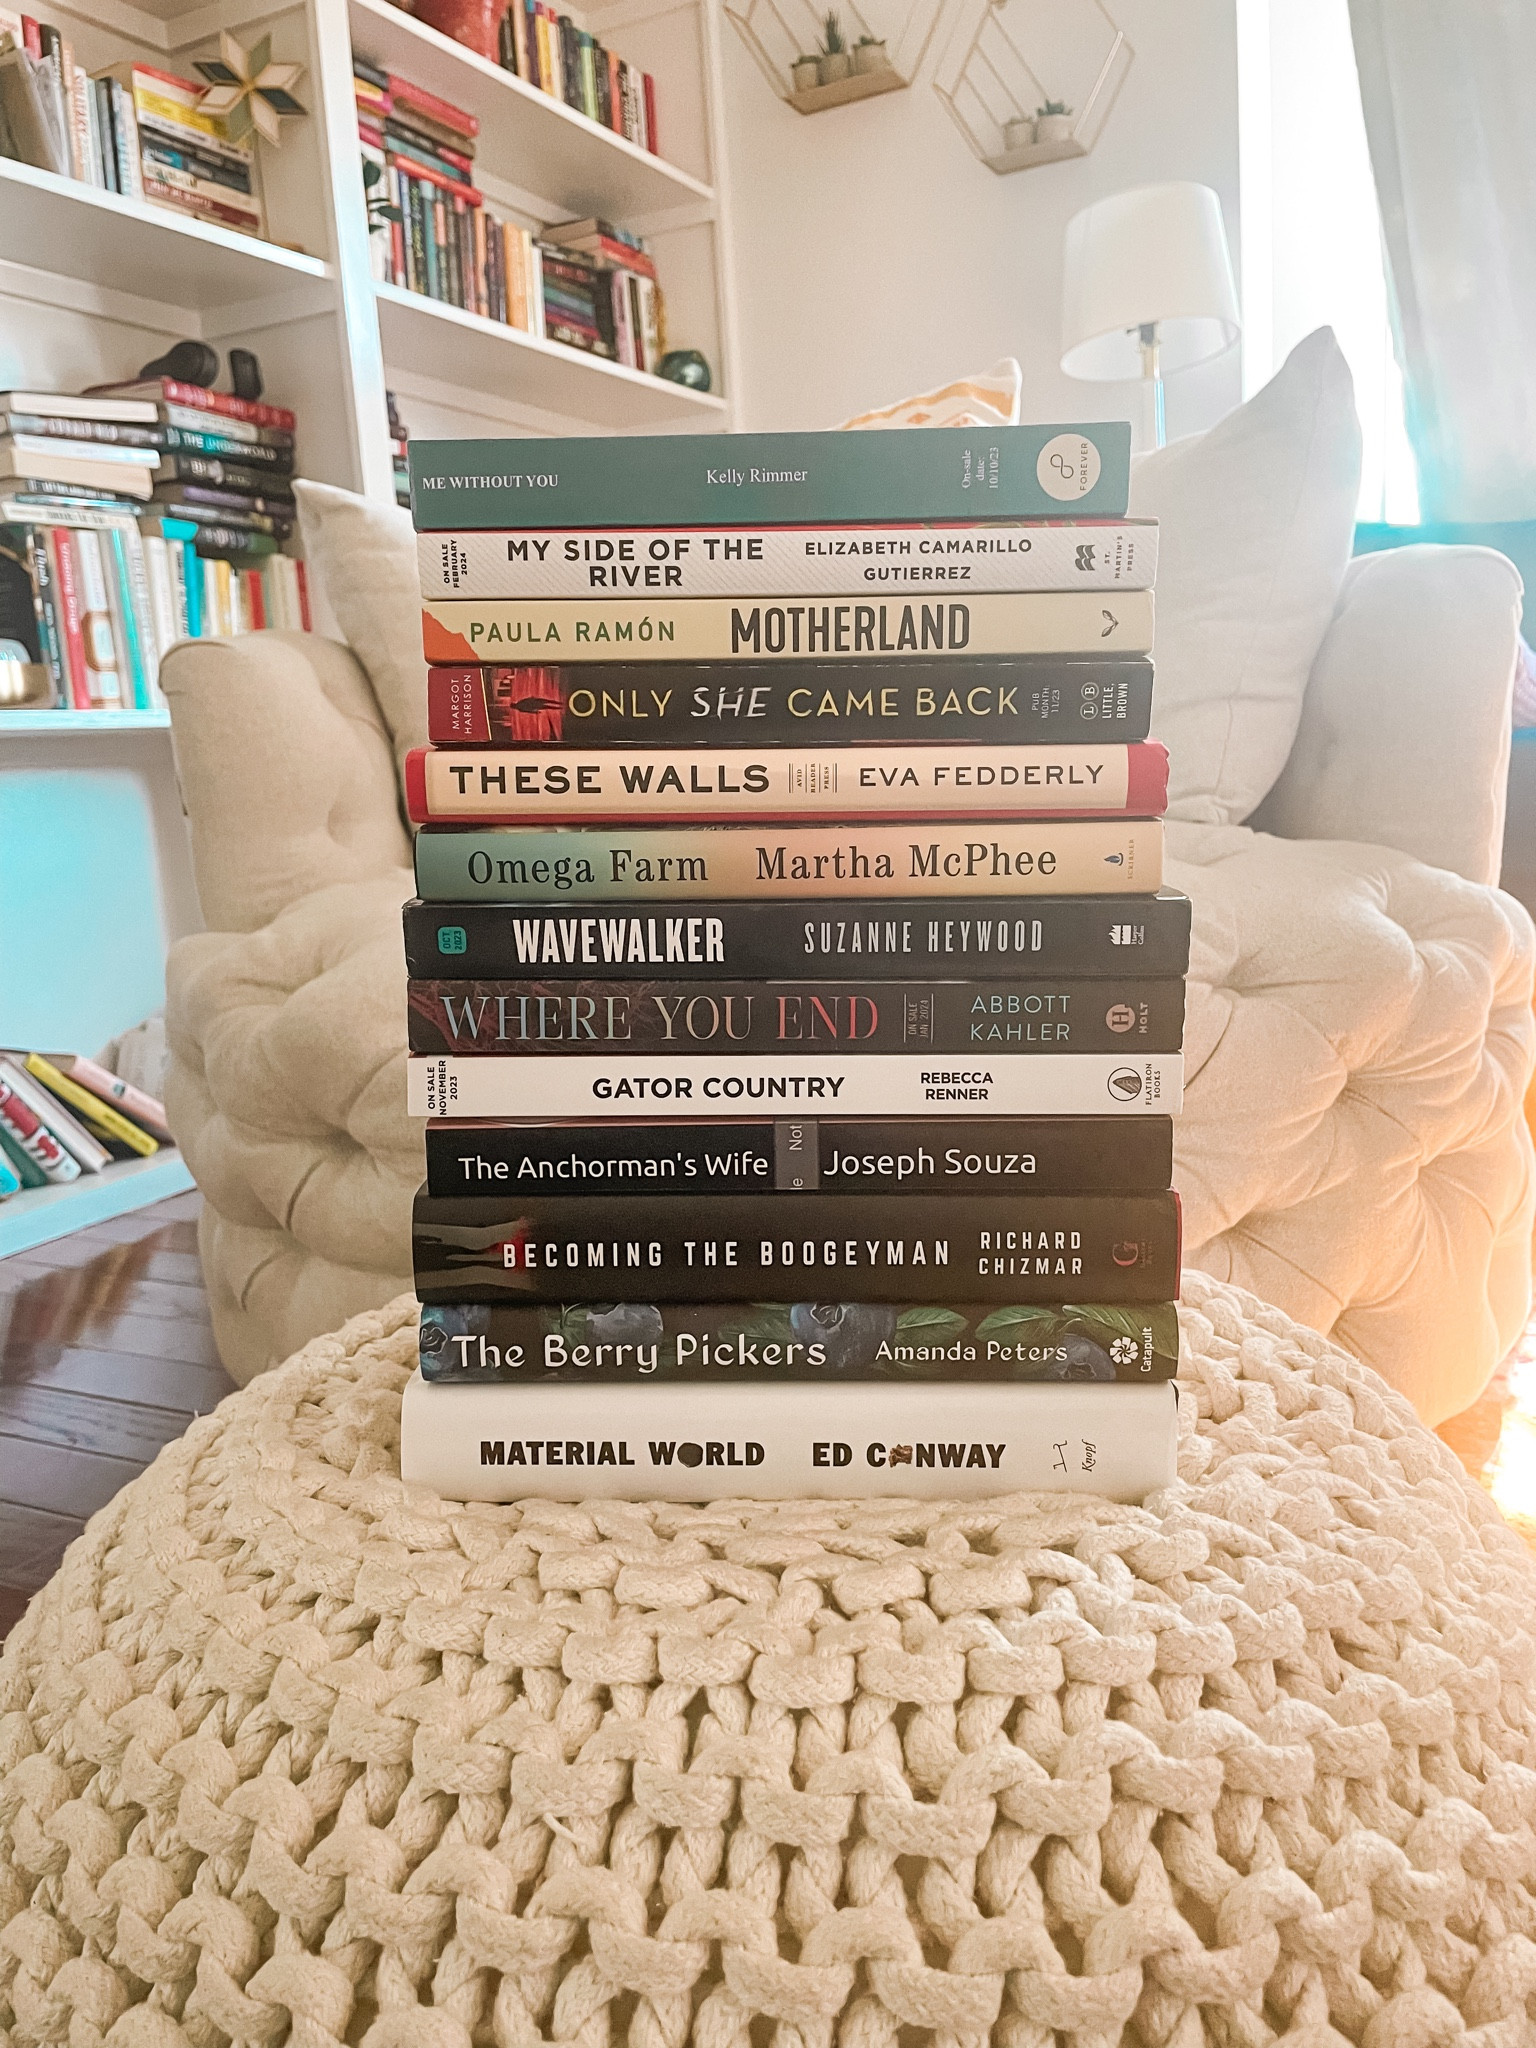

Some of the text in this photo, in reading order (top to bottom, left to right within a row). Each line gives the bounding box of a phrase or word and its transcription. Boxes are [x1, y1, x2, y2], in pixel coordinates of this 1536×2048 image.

[183, 432, 204, 449] THE
[706, 467, 808, 485] Kelly Rimmer
[962, 449, 971, 489] On-sale
[976, 455, 985, 481] date:
[989, 447, 999, 489] 10/10/23
[1080, 442, 1088, 491] FOREVER
[423, 474, 559, 489] ME WITHOUT YOU
[507, 539, 764, 561] MY SIDE OF THE
[805, 539, 1032, 555] ELIZABETH CAMARILLO
[1114, 535, 1123, 579] MARTIN'S
[444, 569, 450, 584] ON
[452, 539, 460, 589] FEBRUARY
[589, 566, 683, 587] RIVER
[864, 567, 972, 580] GUTIERREZ
[470, 617, 675, 643] PAULA RAMÓN
[731, 604, 970, 652] MOTHERLAND
[451, 678, 459, 730] MARGOT
[464, 674, 472, 734] HARRISON
[568, 686, 1018, 721] ONLY SHE CAME BACK
[1031, 693, 1039, 711] PUB
[1052, 689, 1060, 713] 11/23
[1102, 683, 1114, 719] LITTLE,
[1117, 683, 1128, 719] BROWN
[449, 765, 770, 794] THESE WALLS
[860, 765, 1104, 786] EVA FEDDERLY
[468, 850, 709, 889] Omega Farm
[756, 844, 1057, 879] Martha McPhee
[1127, 839, 1135, 879] SCRIBNER
[442, 931, 451, 949] OCT
[454, 930, 464, 951] 2023
[512, 918, 725, 963] WAVEWALKER
[805, 920, 1043, 953] SUZANNE HEYWOOD
[971, 996, 1071, 1014] ABBOTT
[1139, 1002, 1148, 1033] HOLT
[440, 996, 878, 1041] WHERE YOU END
[907, 1003, 917, 1037] ON SALE
[919, 1000, 930, 1038] JAN 2024
[970, 1024, 1070, 1041] KAHLER
[450, 1076, 458, 1099] 2023
[592, 1077, 845, 1099] GATOR COUNTRY
[920, 1072, 993, 1084] REBECCA
[428, 1094, 435, 1109] ON
[926, 1089, 989, 1099] RENNER
[789, 1124, 803, 1151] Not
[458, 1151, 768, 1180] The Anchorman's Wife
[824, 1147, 1036, 1179] Joseph Souza
[980, 1231, 1081, 1250] RICHARD
[503, 1241, 949, 1268] BECOMING THE BOOGEYMAN
[979, 1258, 1082, 1275] CHIZMAR
[1113, 1242, 1139, 1267] G
[451, 1334, 827, 1373] The Berry Pickers
[875, 1341, 1067, 1361] Amanda Peters
[1141, 1327, 1152, 1372] Catapult
[481, 1442, 635, 1466] MATERIAL
[813, 1442, 852, 1467] ED
[1082, 1440, 1096, 1472] Knopf
